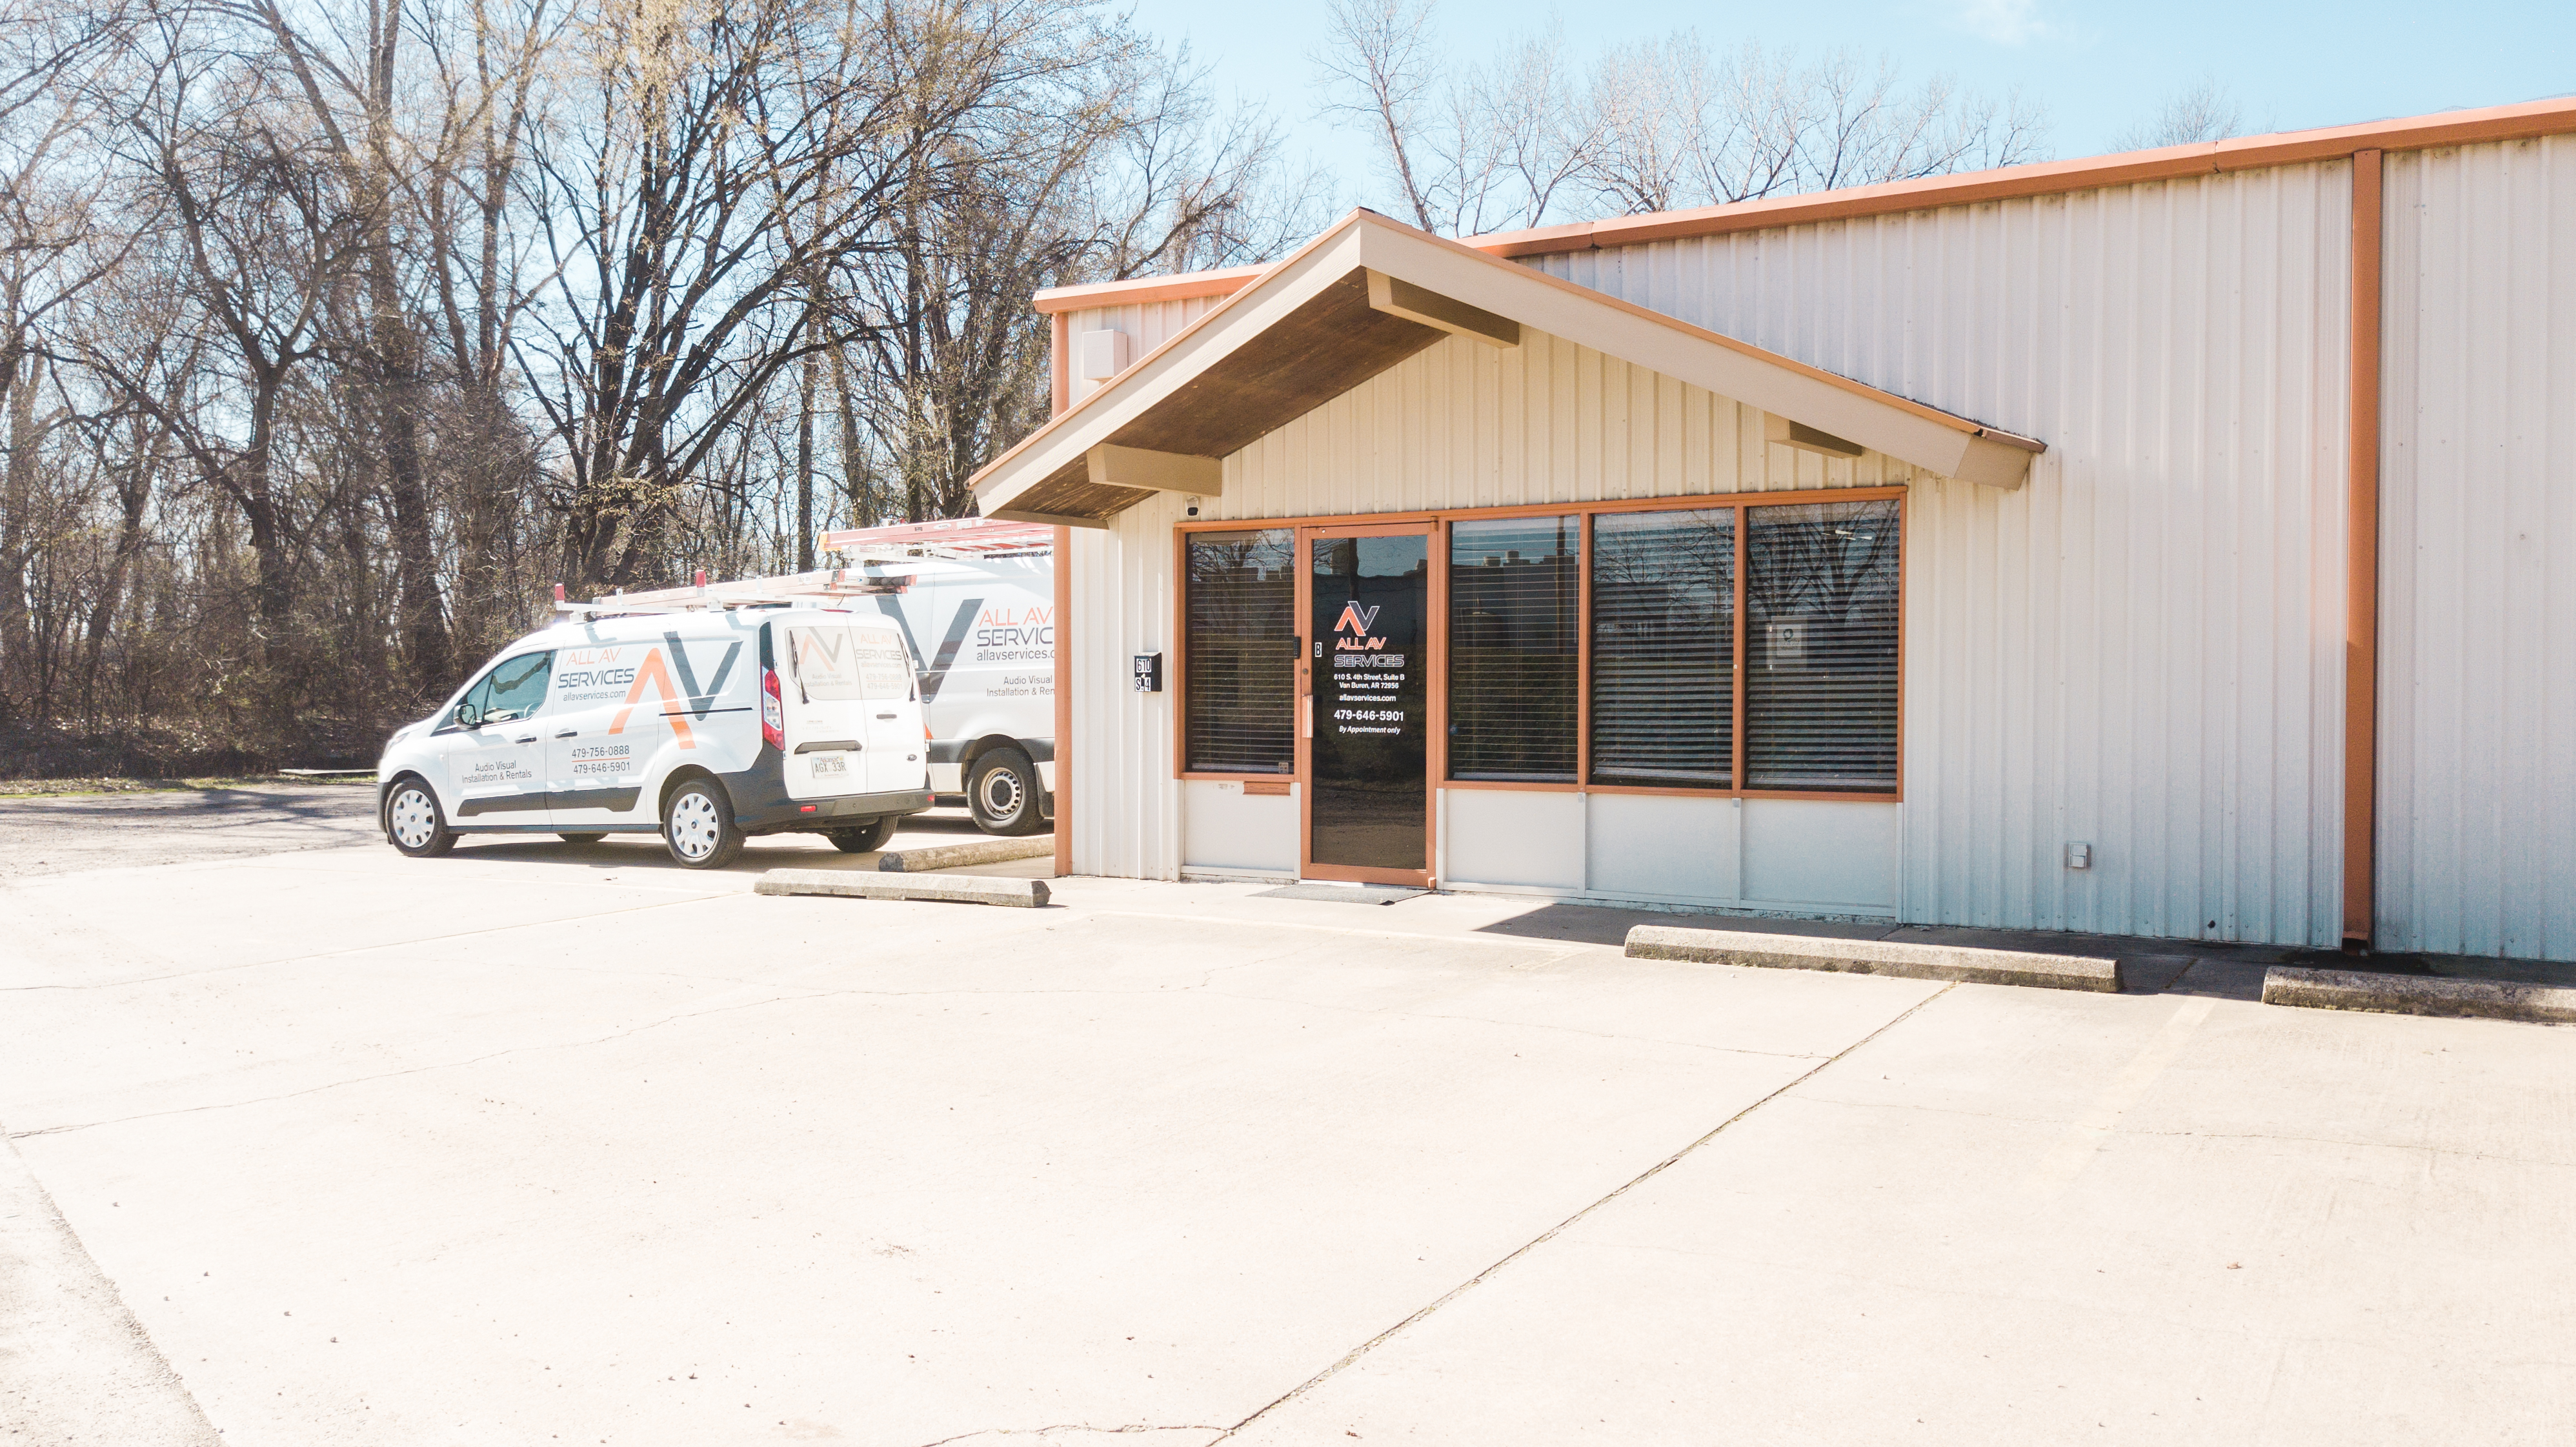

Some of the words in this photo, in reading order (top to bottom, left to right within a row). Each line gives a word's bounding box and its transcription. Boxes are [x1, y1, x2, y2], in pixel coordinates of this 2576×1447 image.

[978, 609, 1018, 627] ALL
[1023, 606, 1054, 625] AV
[860, 634, 880, 644] ALL
[881, 634, 892, 644] AV
[977, 627, 1054, 647] SERVIC
[1335, 637, 1363, 650] ALL
[1365, 637, 1387, 650] AV
[856, 649, 902, 660] SERVICES
[976, 647, 1055, 661] allavservices.c
[1316, 643, 1322, 656] B
[566, 650, 595, 666] ALL
[598, 647, 621, 663] AV
[1334, 654, 1404, 667] SERVICES
[1138, 659, 1151, 671] 610
[558, 668, 635, 689] SERVICES
[1003, 676, 1026, 685] Audio
[1029, 674, 1052, 684] Visual
[563, 690, 626, 702] allavservices.com
[987, 687, 1029, 696] Installation
[1334, 709, 1404, 722] 479-646-5901
[1339, 725, 1347, 734] By
[1347, 725, 1387, 734] Appointment
[1387, 726, 1401, 735] only
[572, 745, 630, 758] 479-756-0888
[475, 762, 494, 773] Audio
[496, 760, 516, 771] Visual
[573, 762, 630, 774] 479-646-5901
[462, 773, 498, 784] Installation
[506, 769, 532, 780] Rentals
